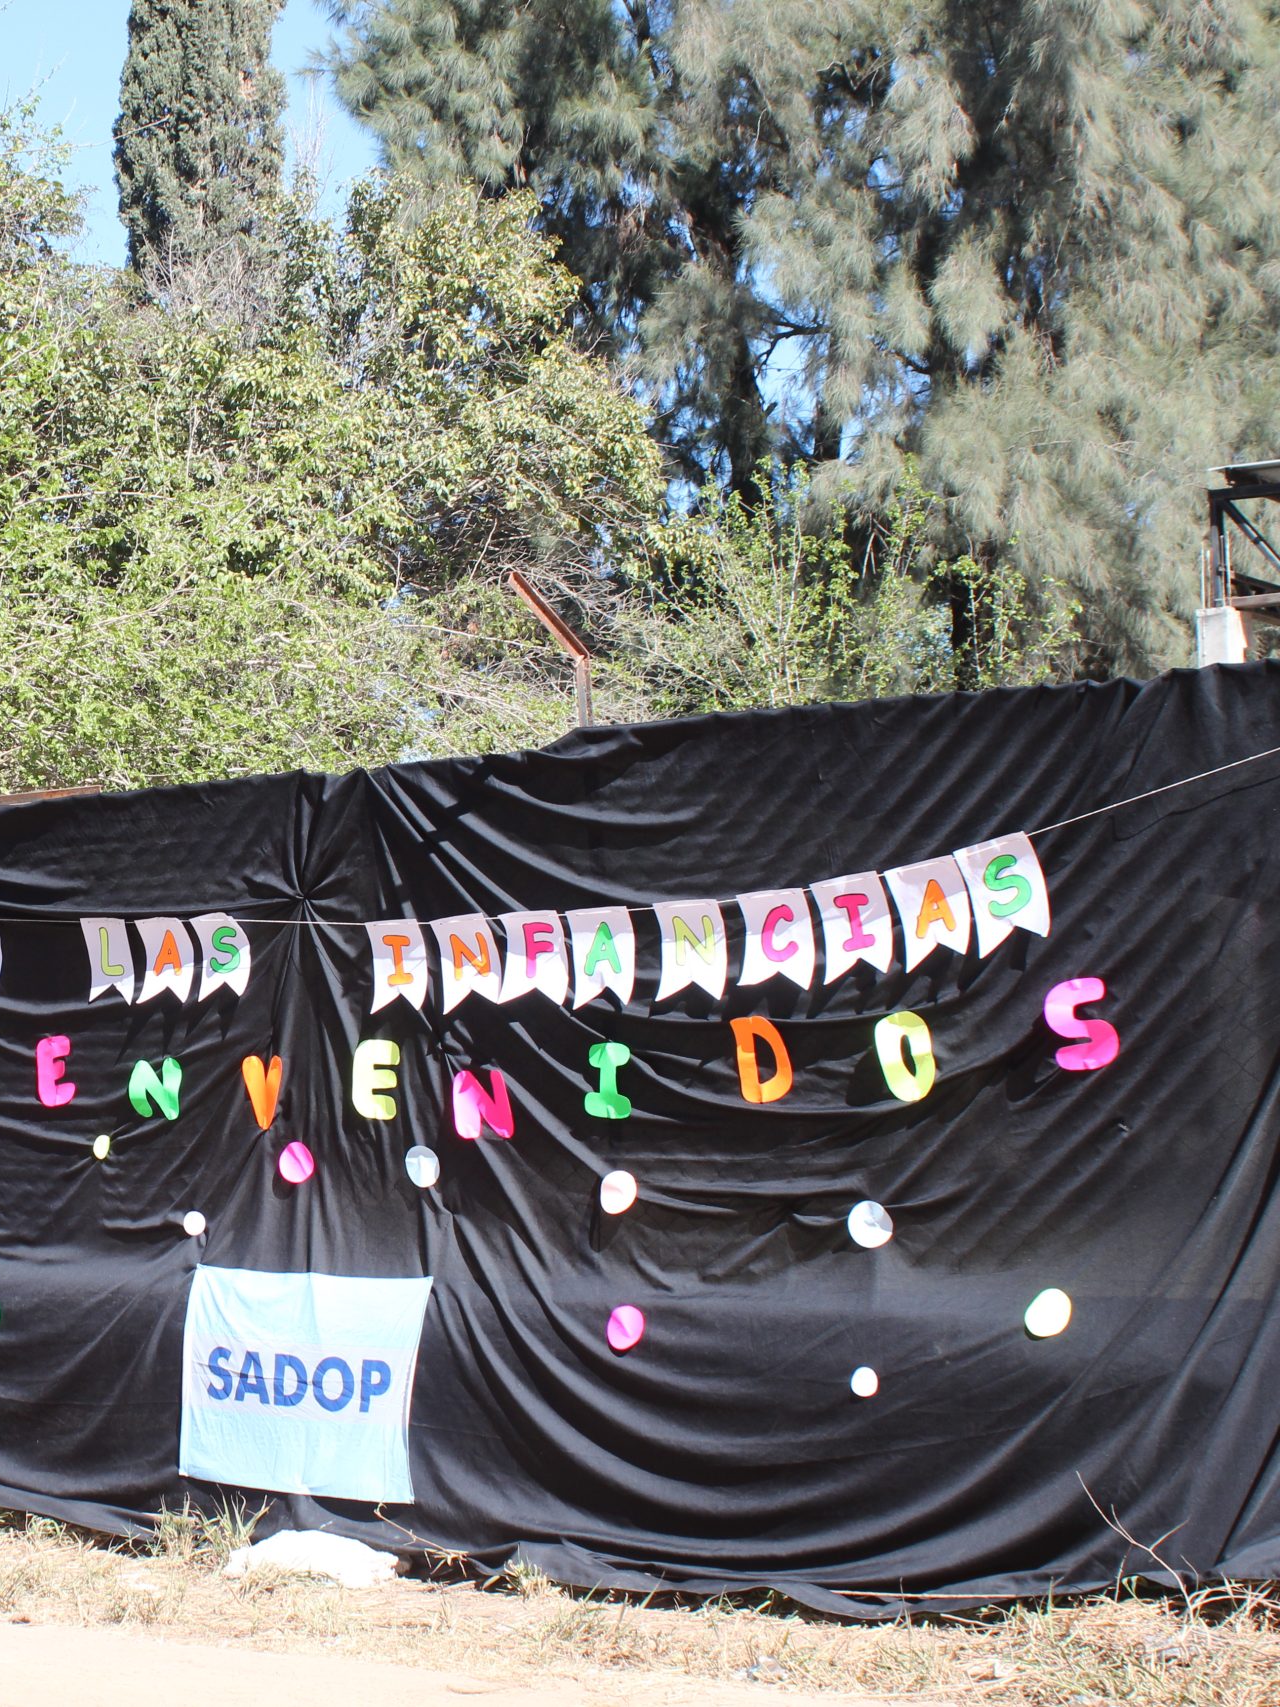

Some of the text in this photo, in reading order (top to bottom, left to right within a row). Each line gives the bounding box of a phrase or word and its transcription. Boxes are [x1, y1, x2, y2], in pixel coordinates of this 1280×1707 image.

[98, 926, 242, 977] LAS
[381, 853, 1033, 987] INFANCIAS
[206, 1345, 392, 1414] SADOP
